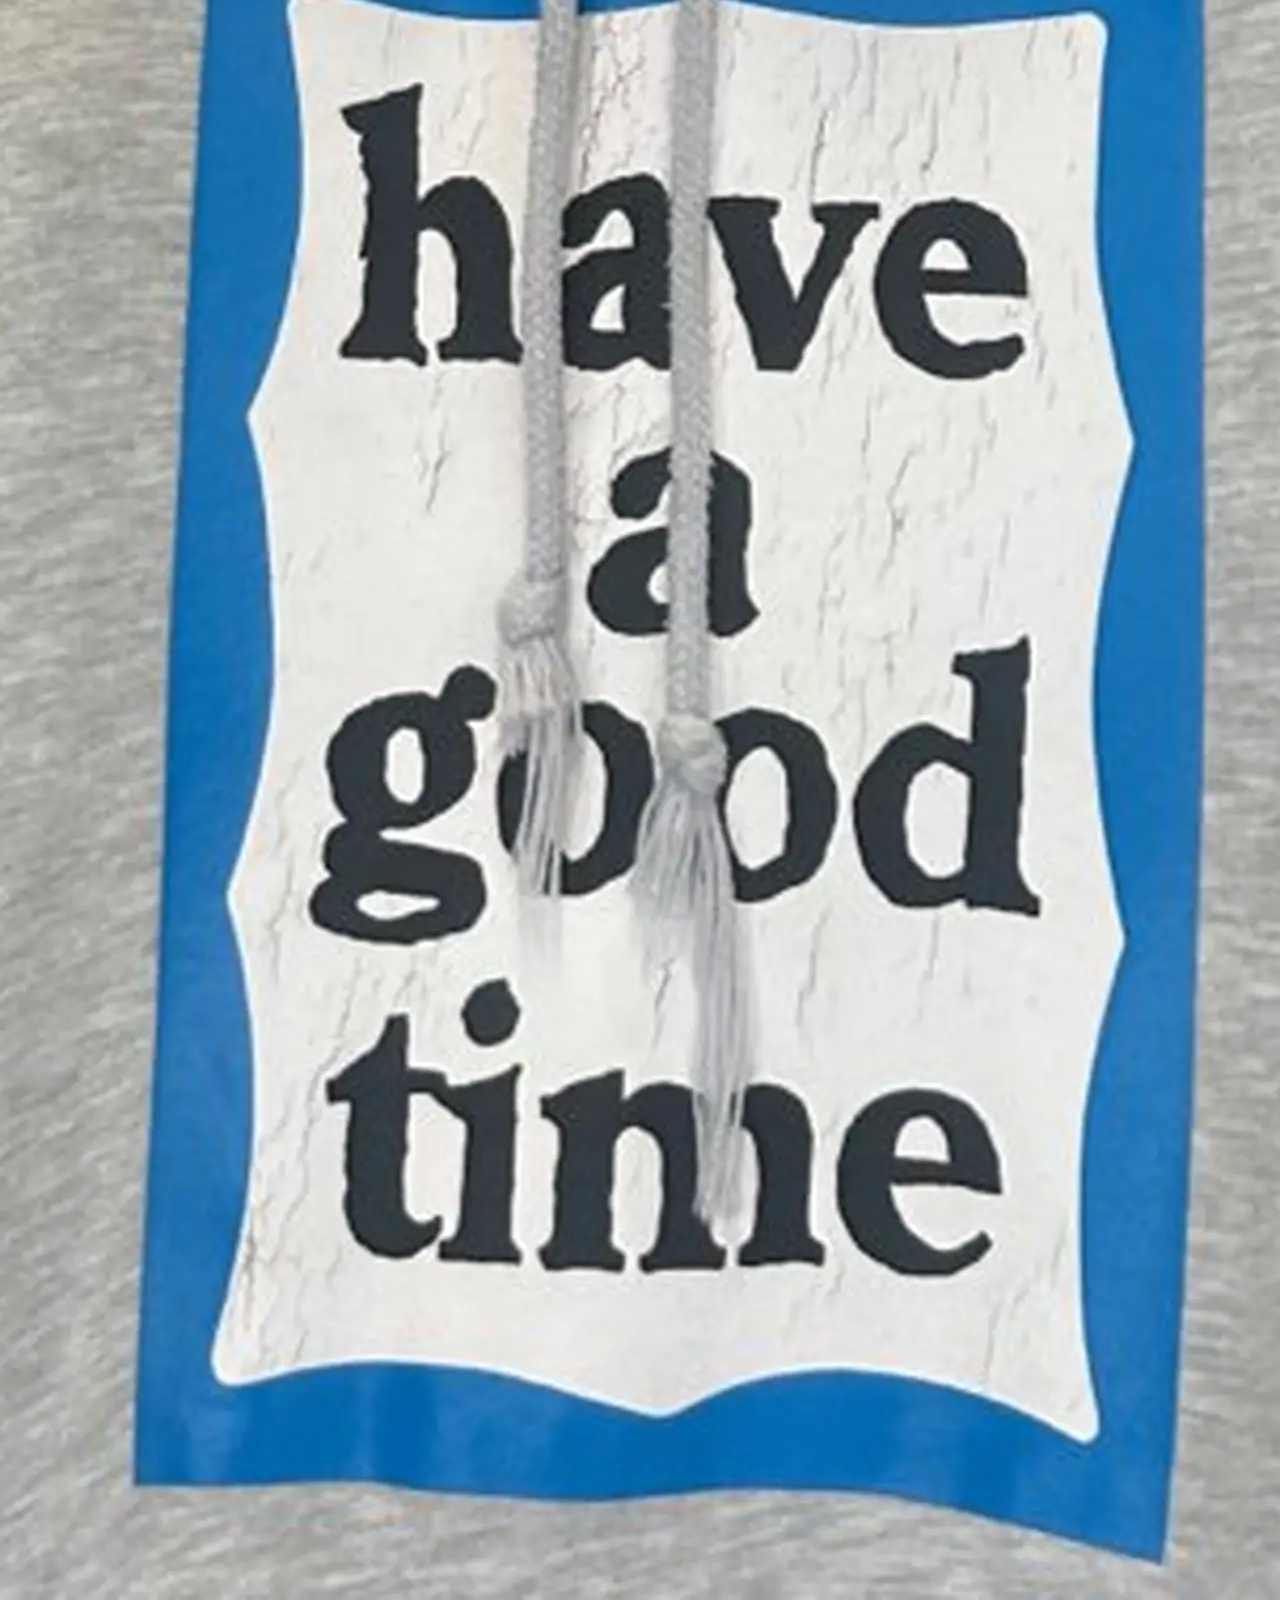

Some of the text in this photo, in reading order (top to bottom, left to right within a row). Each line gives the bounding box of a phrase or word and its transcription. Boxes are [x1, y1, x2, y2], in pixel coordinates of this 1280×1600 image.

[339, 83, 1028, 380] have
[585, 449, 760, 639] a
[308, 637, 1041, 946] good
[324, 977, 1003, 1278] time
